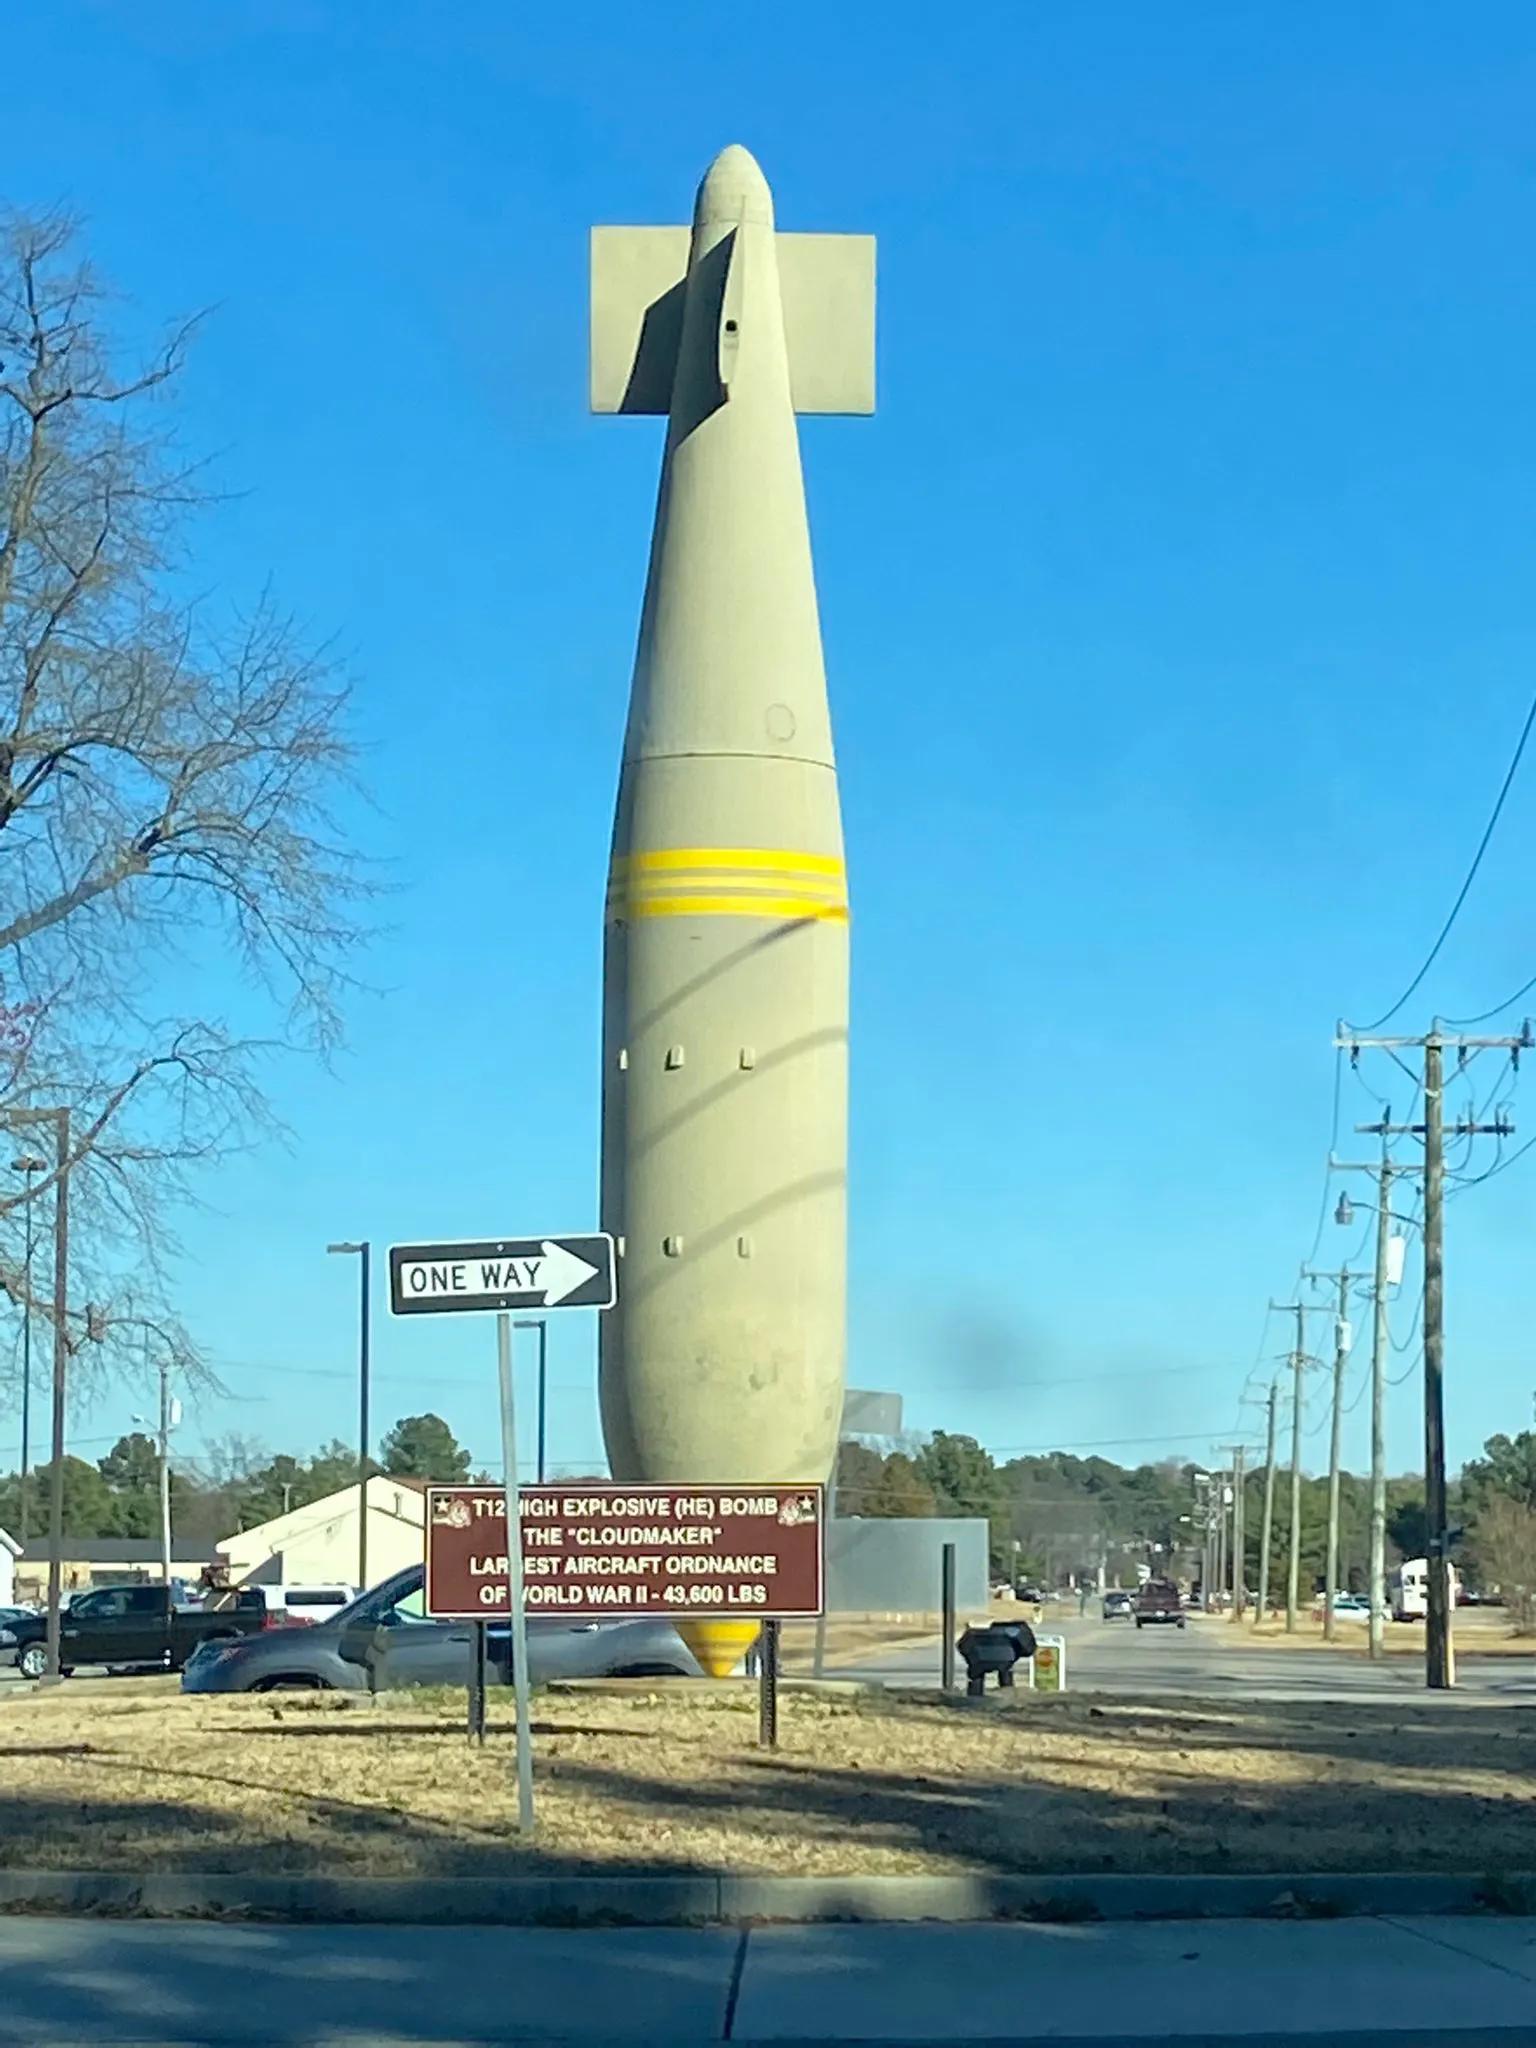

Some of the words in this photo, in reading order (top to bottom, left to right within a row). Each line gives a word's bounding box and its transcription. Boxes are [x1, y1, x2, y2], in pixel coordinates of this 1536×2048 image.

[410, 1265, 467, 1292] ONE
[481, 1261, 541, 1289] WAY
[472, 1498, 505, 1517] T12
[563, 1498, 670, 1517] EXPLOSIVE
[674, 1498, 715, 1520] (HE)
[720, 1498, 778, 1516] BOMB
[523, 1527, 563, 1546] THE
[568, 1527, 722, 1546] "CLOUDMAKER"
[470, 1556, 561, 1575] LAREST
[564, 1556, 662, 1575] AIRCRAFT
[665, 1556, 777, 1574] ORDNANCE
[480, 1585, 507, 1604] OF
[586, 1585, 632, 1604] WAR
[636, 1585, 647, 1604] II
[663, 1585, 723, 1605] 43,600
[728, 1585, 766, 1604] LBS
